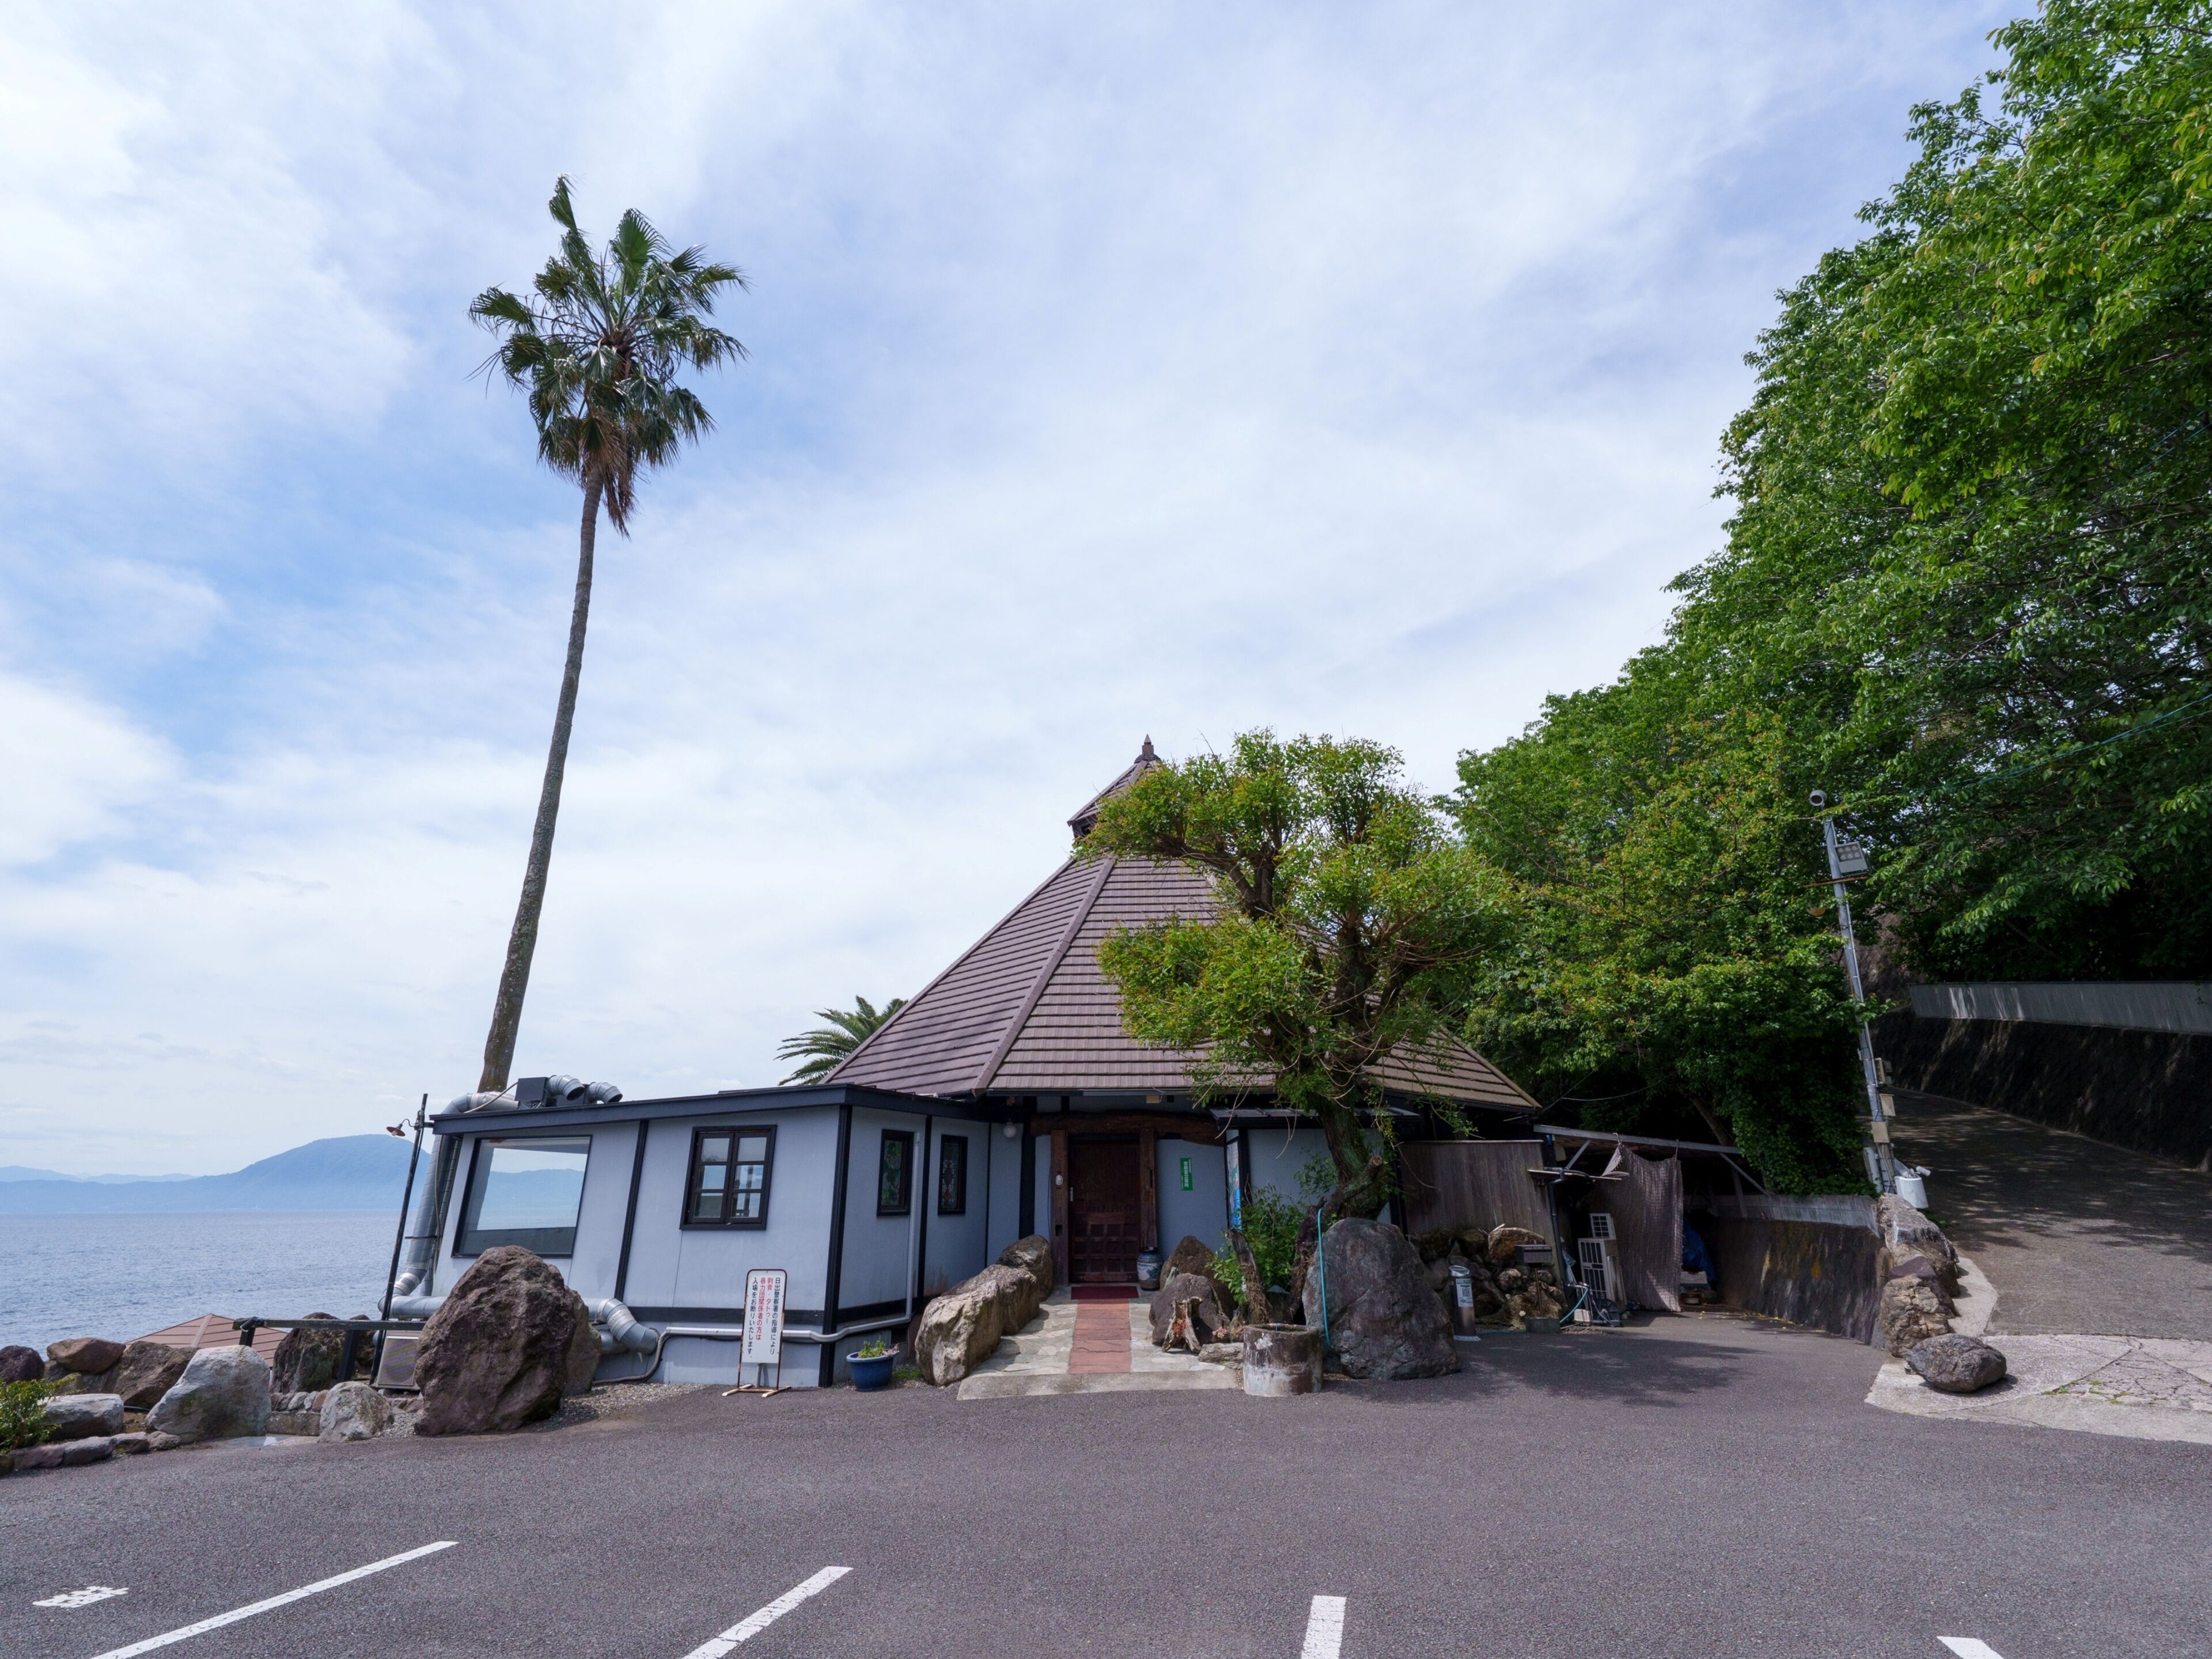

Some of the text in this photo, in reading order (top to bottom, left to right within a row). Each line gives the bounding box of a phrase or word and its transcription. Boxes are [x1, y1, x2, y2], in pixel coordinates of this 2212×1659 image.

[756, 1277, 766, 1340] 暴力団関係者の方は
[770, 1277, 781, 1355] 日出警察署の指導により
